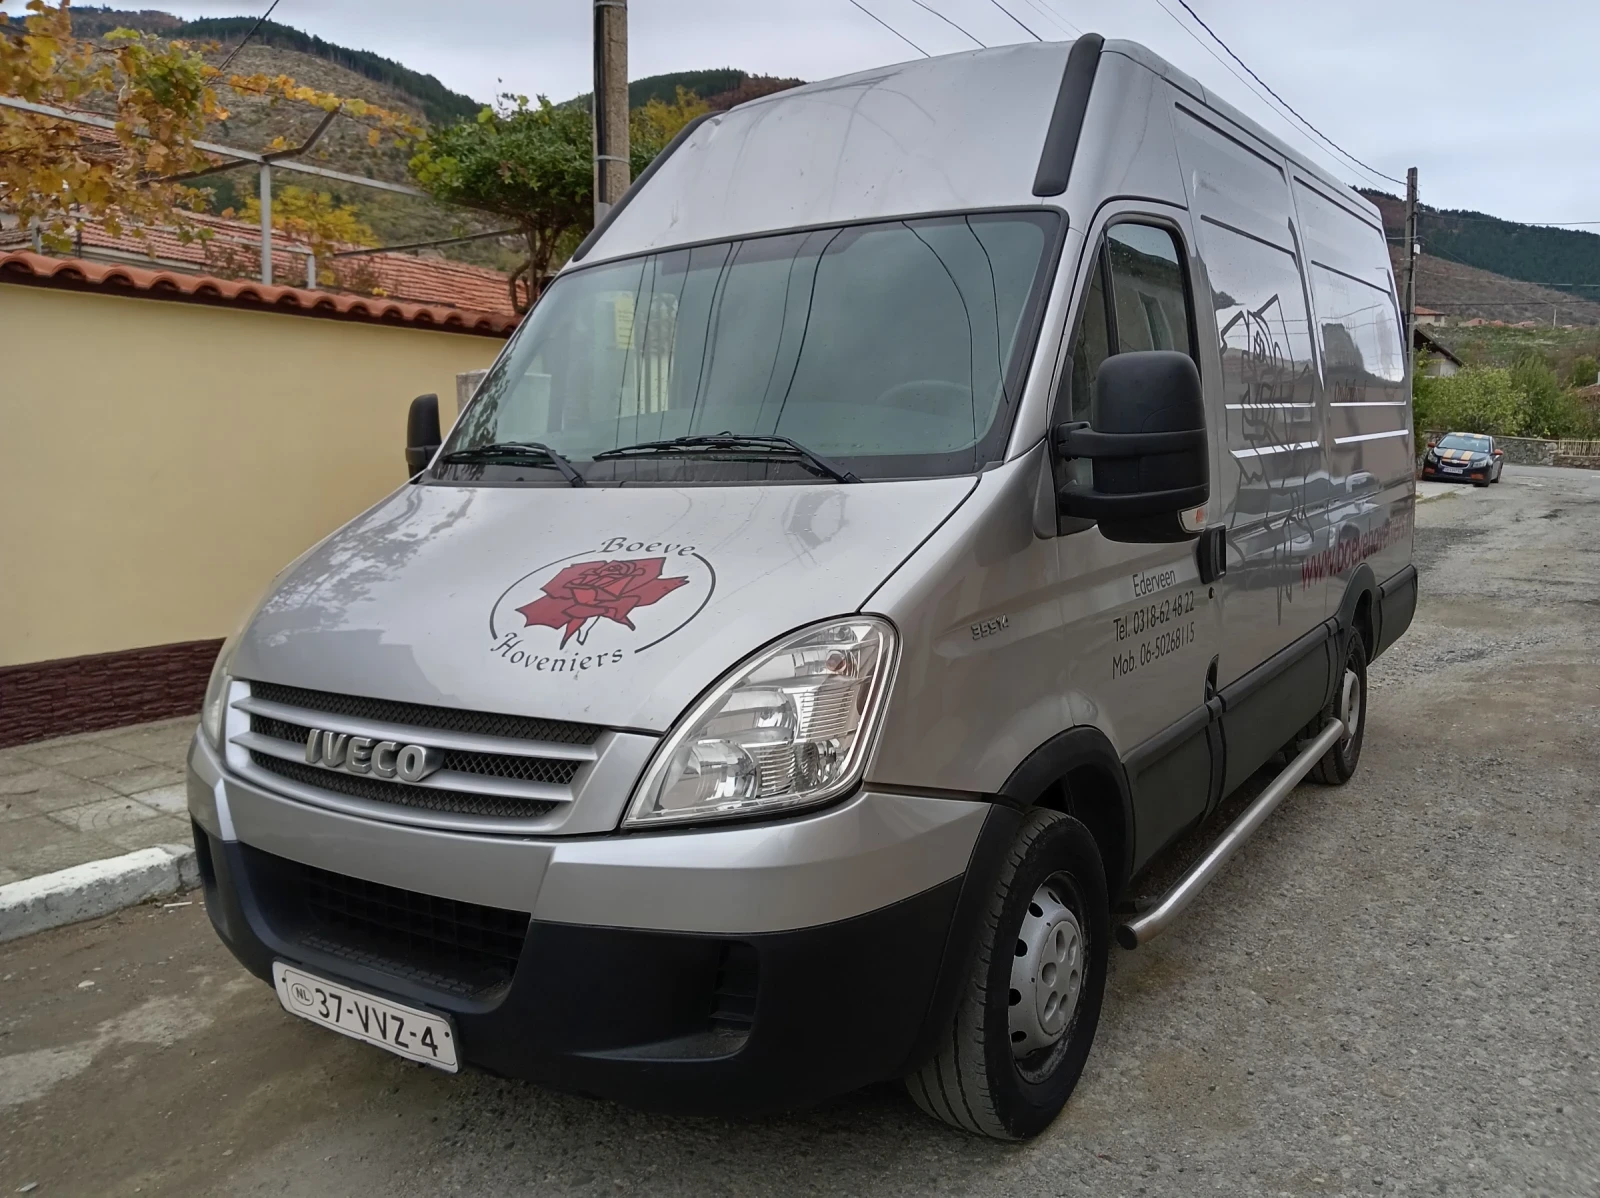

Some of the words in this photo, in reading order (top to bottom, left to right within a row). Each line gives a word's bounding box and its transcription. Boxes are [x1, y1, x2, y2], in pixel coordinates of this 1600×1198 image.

[599, 536, 696, 557] Boeve
[1132, 569, 1177, 597] Ederveen
[1113, 616, 1131, 643] Tel.
[1133, 599, 1170, 635] 0318-62
[1172, 595, 1182, 618] 48
[1185, 590, 1194, 614] 22
[490, 632, 623, 673] Hoveniers
[1112, 649, 1137, 680] Mob.
[1140, 621, 1195, 666] 06-50268115
[305, 728, 428, 782] IVECO
[295, 986, 311, 1002] NL
[315, 988, 439, 1057] 37-VVZ-4
